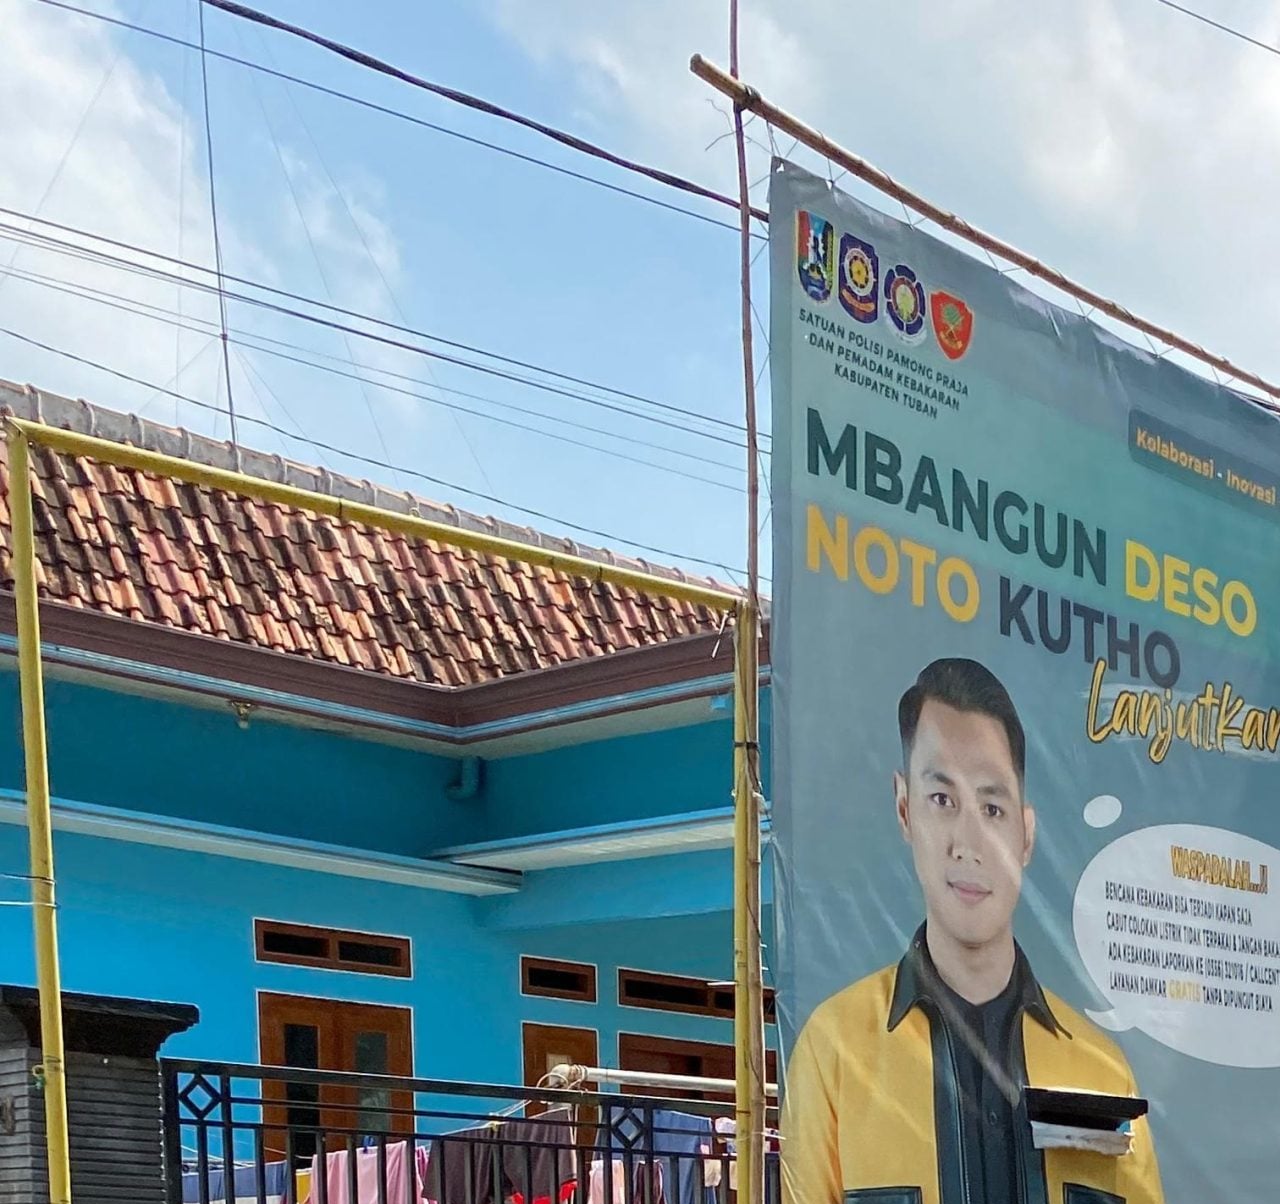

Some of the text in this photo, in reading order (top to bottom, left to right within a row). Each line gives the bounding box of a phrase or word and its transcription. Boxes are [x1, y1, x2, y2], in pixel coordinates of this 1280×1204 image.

[799, 308, 969, 397] SATUAN POLISI PAMONG PRAJA
[808, 332, 960, 411] DAN PEMADAM KEBAKARAN
[834, 362, 938, 419] KABUPATEN TUBAN
[1136, 427, 1214, 480] Kolaborasi
[1226, 469, 1276, 505] Inovasi
[806, 406, 1258, 638] MBANGUN DESO
[806, 504, 1181, 689] NOTO KUTHO
[1105, 880, 1135, 905] BENCANA
[1136, 887, 1174, 912] KEBAKARAN
[1175, 895, 1188, 914] BISA
[1189, 897, 1215, 920] TERJADI
[1216, 903, 1236, 924] KAPAN
[1106, 910, 1127, 933] CABUT
[1128, 914, 1159, 938] COLOKAN
[1160, 921, 1182, 943] LISTRIK
[1183, 925, 1201, 946] TIDAK
[1202, 928, 1231, 951] TERPAKAI
[1108, 941, 1121, 961] ADA
[1123, 943, 1160, 968] KEBAKARAN
[1161, 952, 1195, 973] LAPORKAN
[1110, 971, 1139, 994] LAYANAN
[1140, 976, 1167, 998] DAMKAR
[1203, 986, 1222, 1005] TANPA
